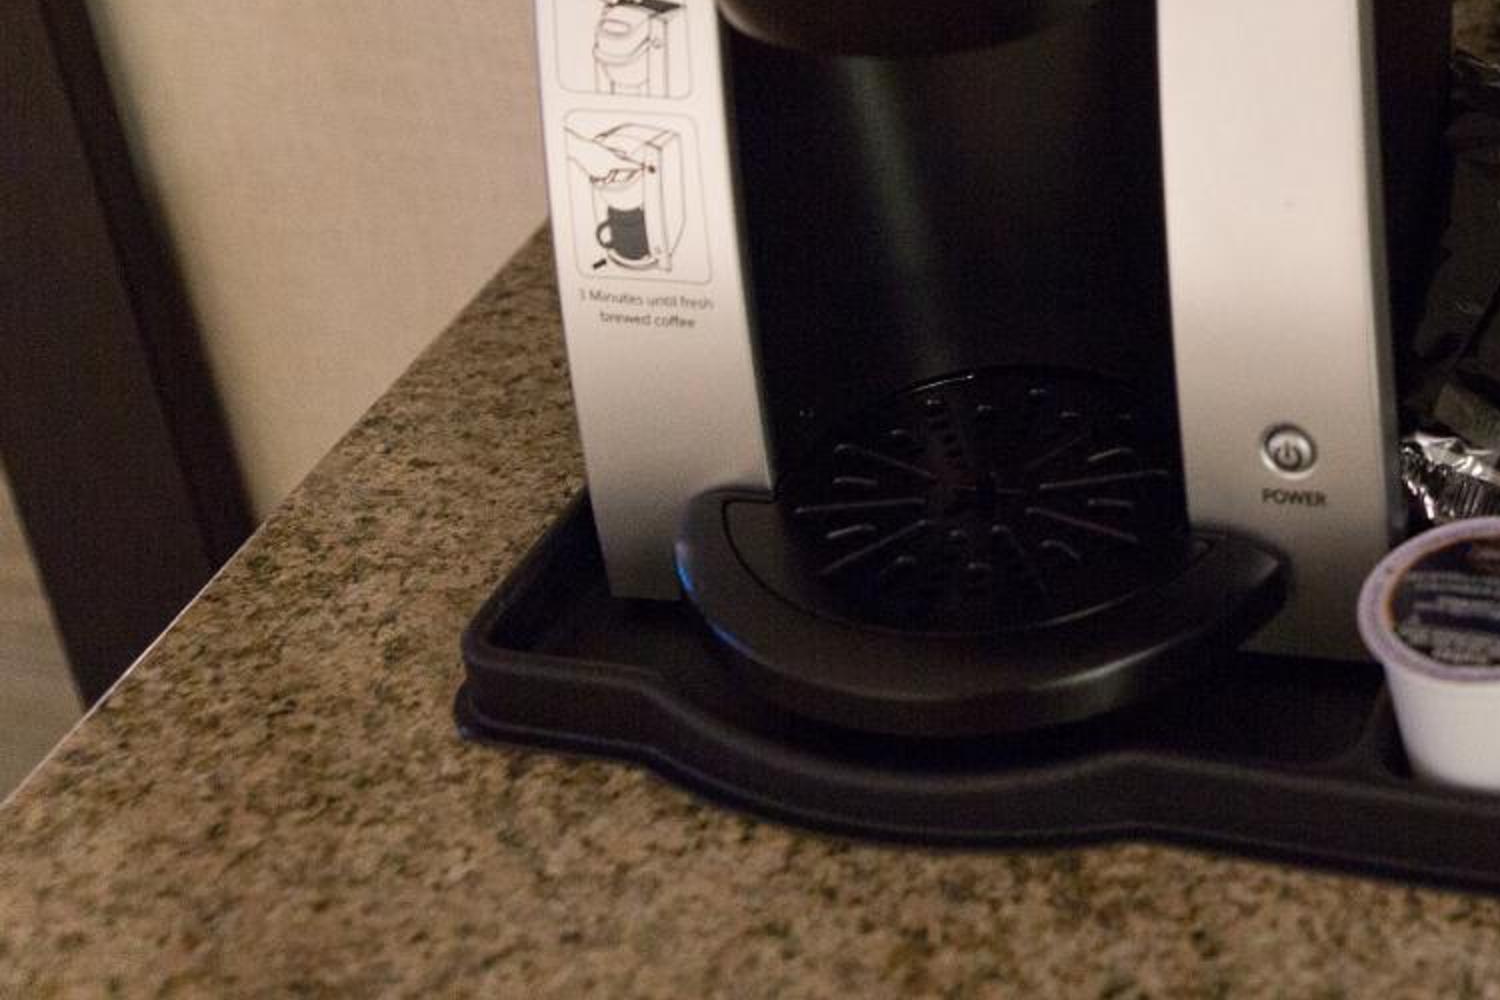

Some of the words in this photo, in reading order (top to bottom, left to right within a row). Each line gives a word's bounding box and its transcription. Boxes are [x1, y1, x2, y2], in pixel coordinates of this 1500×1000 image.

[588, 289, 643, 306] Minutes
[679, 295, 715, 310] fresh
[600, 310, 651, 326] brewed
[654, 314, 696, 328] coffee
[1261, 487, 1327, 507] POWER
